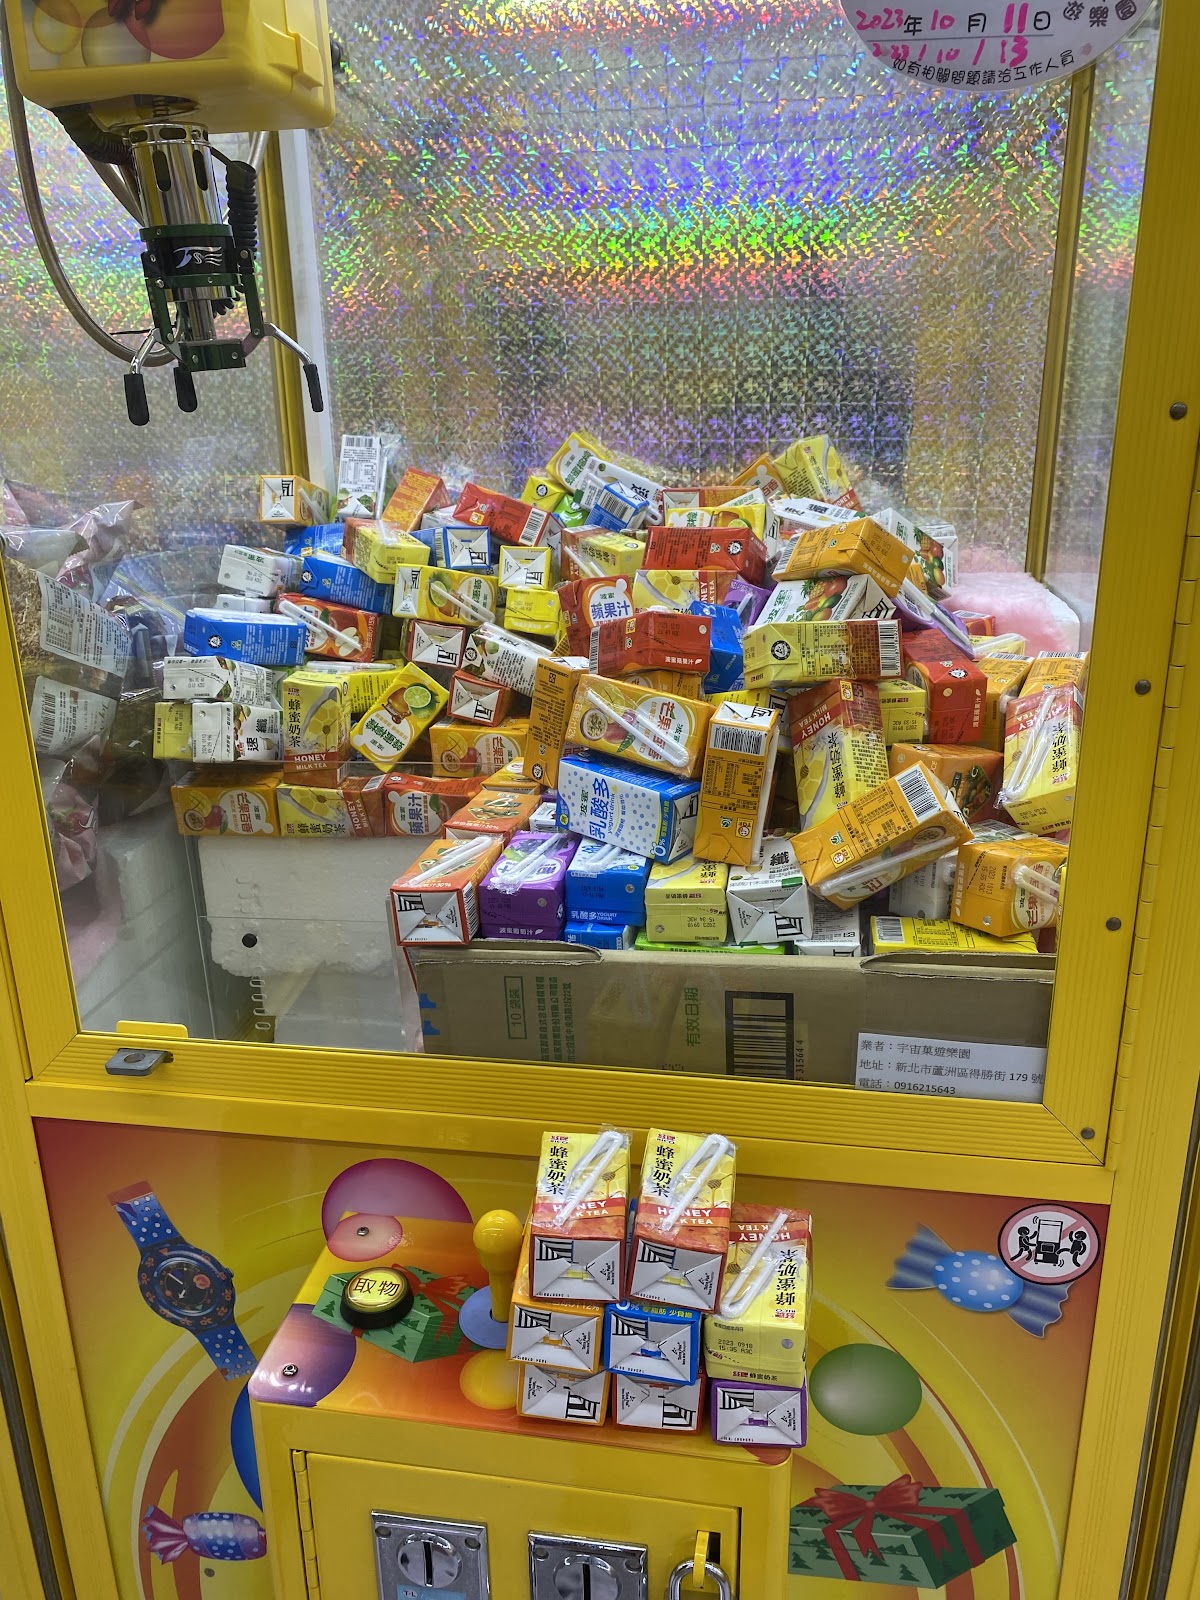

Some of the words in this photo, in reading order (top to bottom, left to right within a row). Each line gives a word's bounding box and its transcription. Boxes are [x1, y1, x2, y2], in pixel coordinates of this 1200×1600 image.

[856, 8, 903, 31] 2023
[903, 15, 923, 36] 年
[930, 9, 955, 31] 10
[967, 12, 987, 33] 月
[1003, 3, 1027, 34] 11
[1033, 11, 1051, 31] 日
[590, 601, 630, 619] 蘋果汁
[288, 699, 301, 747] 蜂蜜奶茶
[801, 712, 831, 740] HONEY
[294, 754, 326, 762] HONEY
[1052, 720, 1068, 772] 蜂蜜奶茶
[828, 732, 846, 799] 蜂蜜奶茶
[346, 800, 361, 829] HONEY
[407, 793, 424, 834] 蘋果汁
[589, 778, 610, 839] 乳酸多
[571, 911, 597, 920] 乳酸多
[509, 988, 521, 1010] 袋裝
[511, 1013, 522, 1026] 10
[684, 986, 700, 1047] 有效日期
[860, 1040, 971, 1059] 業者：宇宙菓遊樂園
[859, 1059, 1006, 1082] 地址：新北市蘆洲區得勝街
[1009, 1073, 1028, 1082] 179
[1031, 1073, 1045, 1084] 號
[858, 1078, 956, 1094] 電話：0916215643
[546, 1146, 568, 1195] 蜂蜜奶茶
[651, 1145, 675, 1198] 蜂蜜奶茶
[553, 1200, 607, 1212] HNEY
[586, 1209, 608, 1217] TEA
[657, 1206, 711, 1217] HNEY
[353, 1277, 400, 1297] 取物
[776, 1249, 798, 1305] 蜂蜜奶茶
[718, 1338, 734, 1346] 2023
